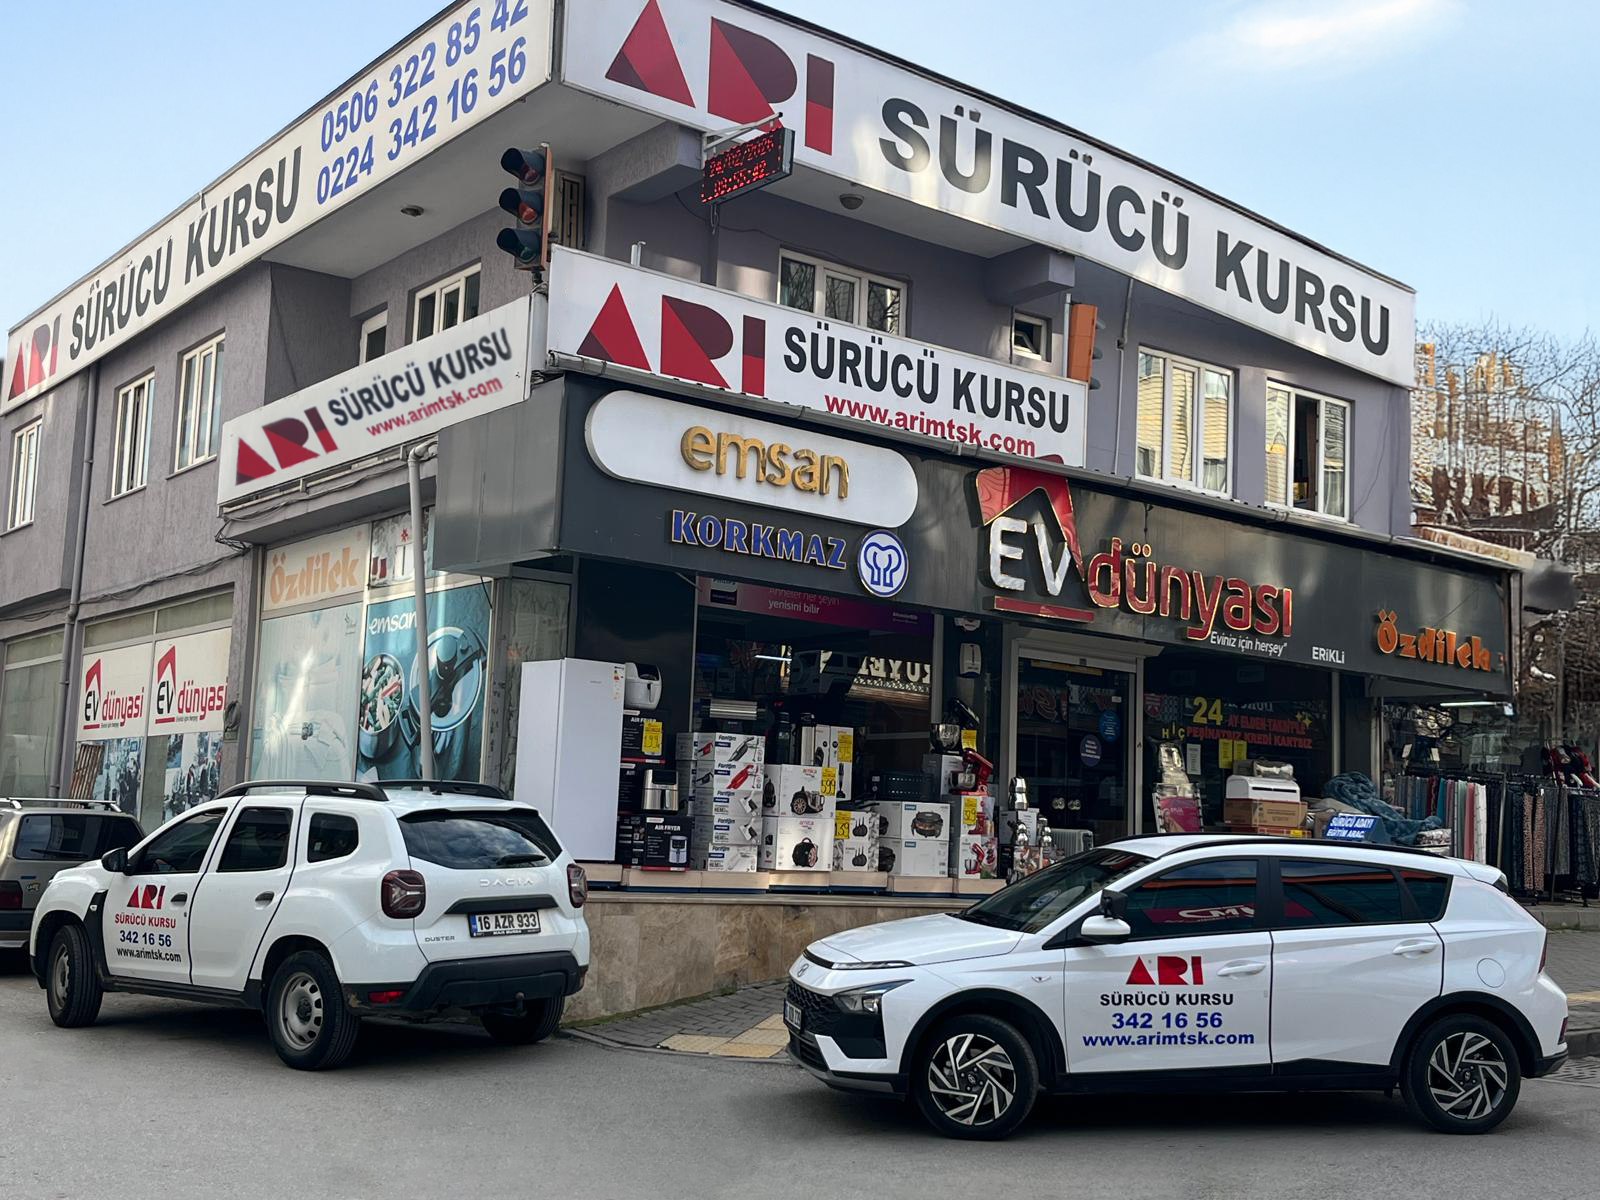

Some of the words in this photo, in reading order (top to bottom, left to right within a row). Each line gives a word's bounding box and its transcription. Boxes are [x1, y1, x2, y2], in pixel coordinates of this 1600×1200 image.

[320, 82, 378, 152] 0506
[387, 43, 436, 107] 322
[445, 5, 481, 66] 85
[491, 0, 529, 32] 42
[316, 135, 374, 205] 0224
[387, 97, 437, 161] 342
[446, 69, 478, 121] 16
[487, 37, 527, 96] 56
[605, 0, 835, 156] ARI
[878, 97, 1190, 270] SÜRÜCÜ
[1214, 229, 1390, 356] KURSU
[9, 314, 61, 398] ARI
[69, 234, 175, 361] SÜRÜCÜ
[184, 146, 302, 286] KURSU
[576, 282, 766, 397] ARI
[784, 321, 940, 404] SÜRÜCÜ
[952, 368, 1070, 433] KURSU
[235, 407, 339, 485] ARI
[327, 361, 426, 427] SÜRÜCÜ
[429, 328, 512, 384] KURSU
[366, 375, 503, 440] www.arimtsk.com
[824, 394, 1036, 457] www.arimtsk.com
[680, 425, 850, 499] emsan
[671, 509, 847, 570] KORKMAZ
[269, 547, 361, 605] Özdilek
[988, 516, 1072, 596] EV
[1087, 536, 1293, 641] dünyası
[768, 599, 801, 611] yenisini
[803, 602, 820, 614] bilir
[1210, 631, 1236, 647] Eviniz
[1238, 636, 1253, 652] için
[1377, 608, 1491, 672] Özdilek
[84, 690, 99, 721] EV
[157, 680, 175, 714] EV
[1193, 697, 1224, 725] 24
[127, 884, 165, 909] ARI
[480, 877, 534, 888] DACIA
[115, 911, 146, 926] SÜRÜCÜ
[148, 916, 176, 929] KURSU
[478, 916, 490, 930] 16
[494, 915, 514, 929] AZR
[517, 913, 537, 928] 933
[120, 930, 138, 944] 342
[142, 933, 155, 945] 16
[158, 934, 171, 947] 56
[425, 935, 455, 943] DUSTER
[117, 947, 181, 963] www.arimtsk.com
[1125, 955, 1204, 985] ARI
[1100, 991, 1170, 1006] SÜRÜCÜ
[1176, 993, 1234, 1006] KURSU
[1112, 1012, 1153, 1029] 342
[1161, 1012, 1188, 1028] 16
[1196, 1012, 1223, 1028] 56
[1082, 1031, 1255, 1047] www.arimtsk.com
